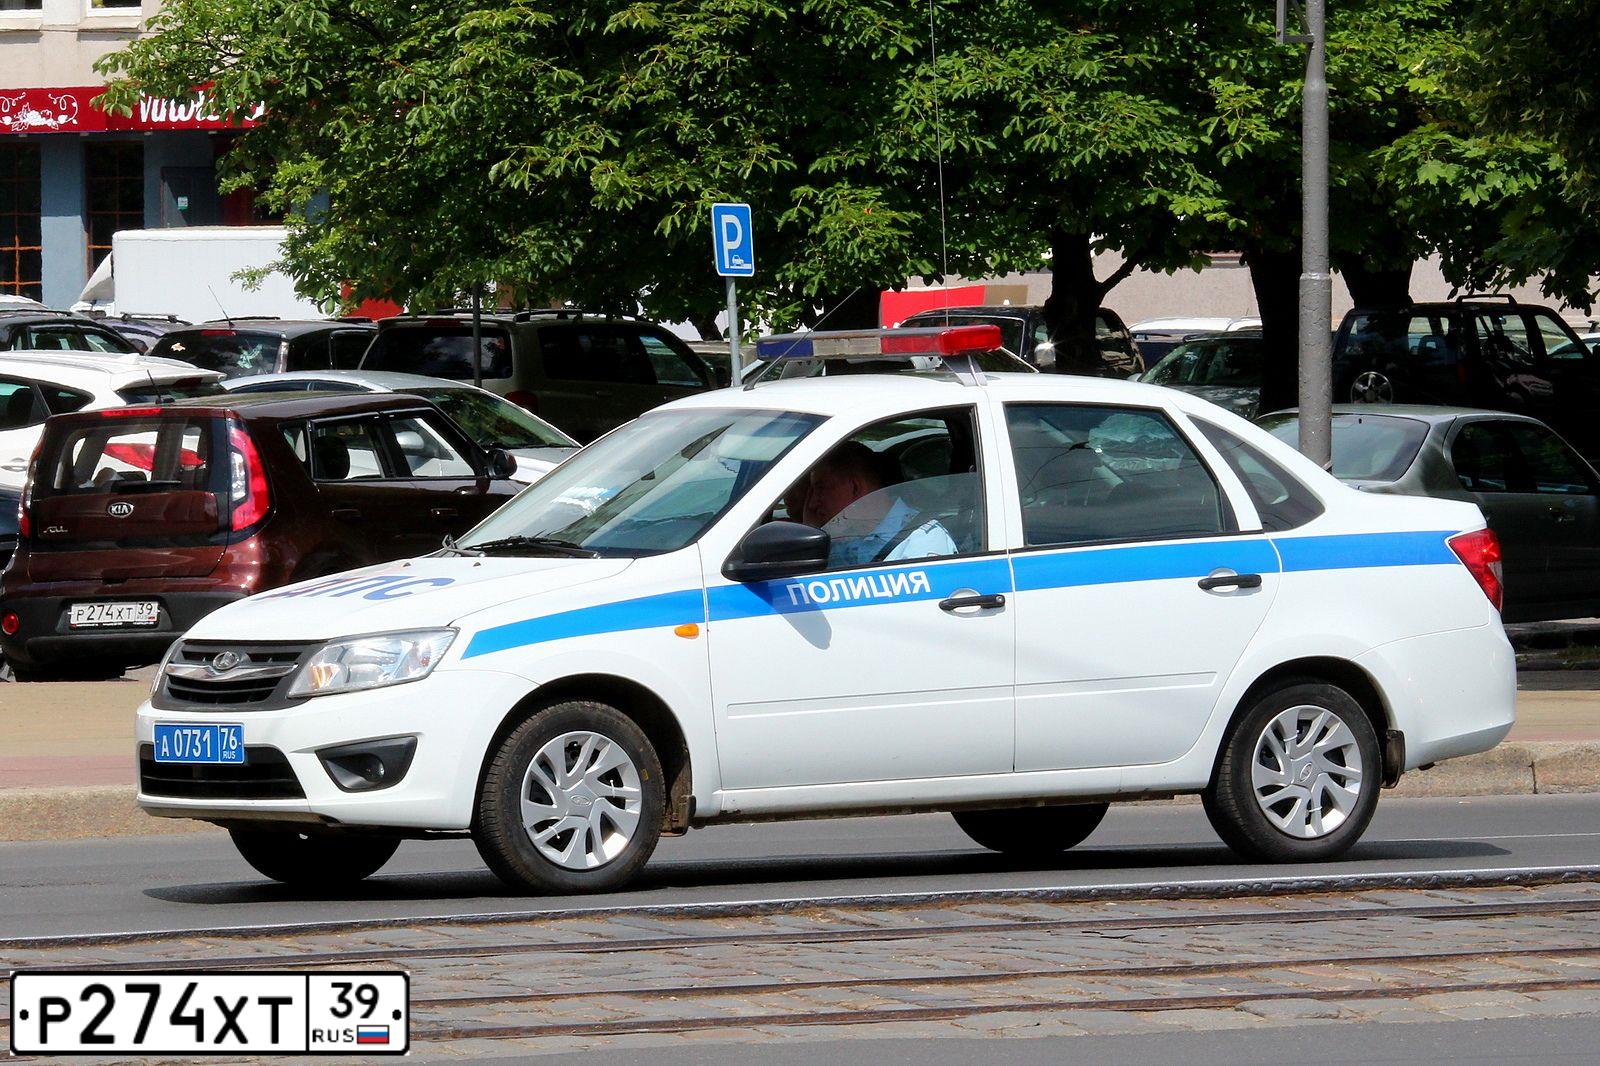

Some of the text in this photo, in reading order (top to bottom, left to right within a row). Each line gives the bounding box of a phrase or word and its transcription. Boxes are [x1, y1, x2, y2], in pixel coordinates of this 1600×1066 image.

[721, 214, 743, 269] P
[111, 505, 129, 514] KIA
[786, 570, 931, 605] ПОЛИЦИЯ
[138, 602, 153, 615] 39
[220, 727, 238, 750] 76
[222, 750, 236, 760] RUS
